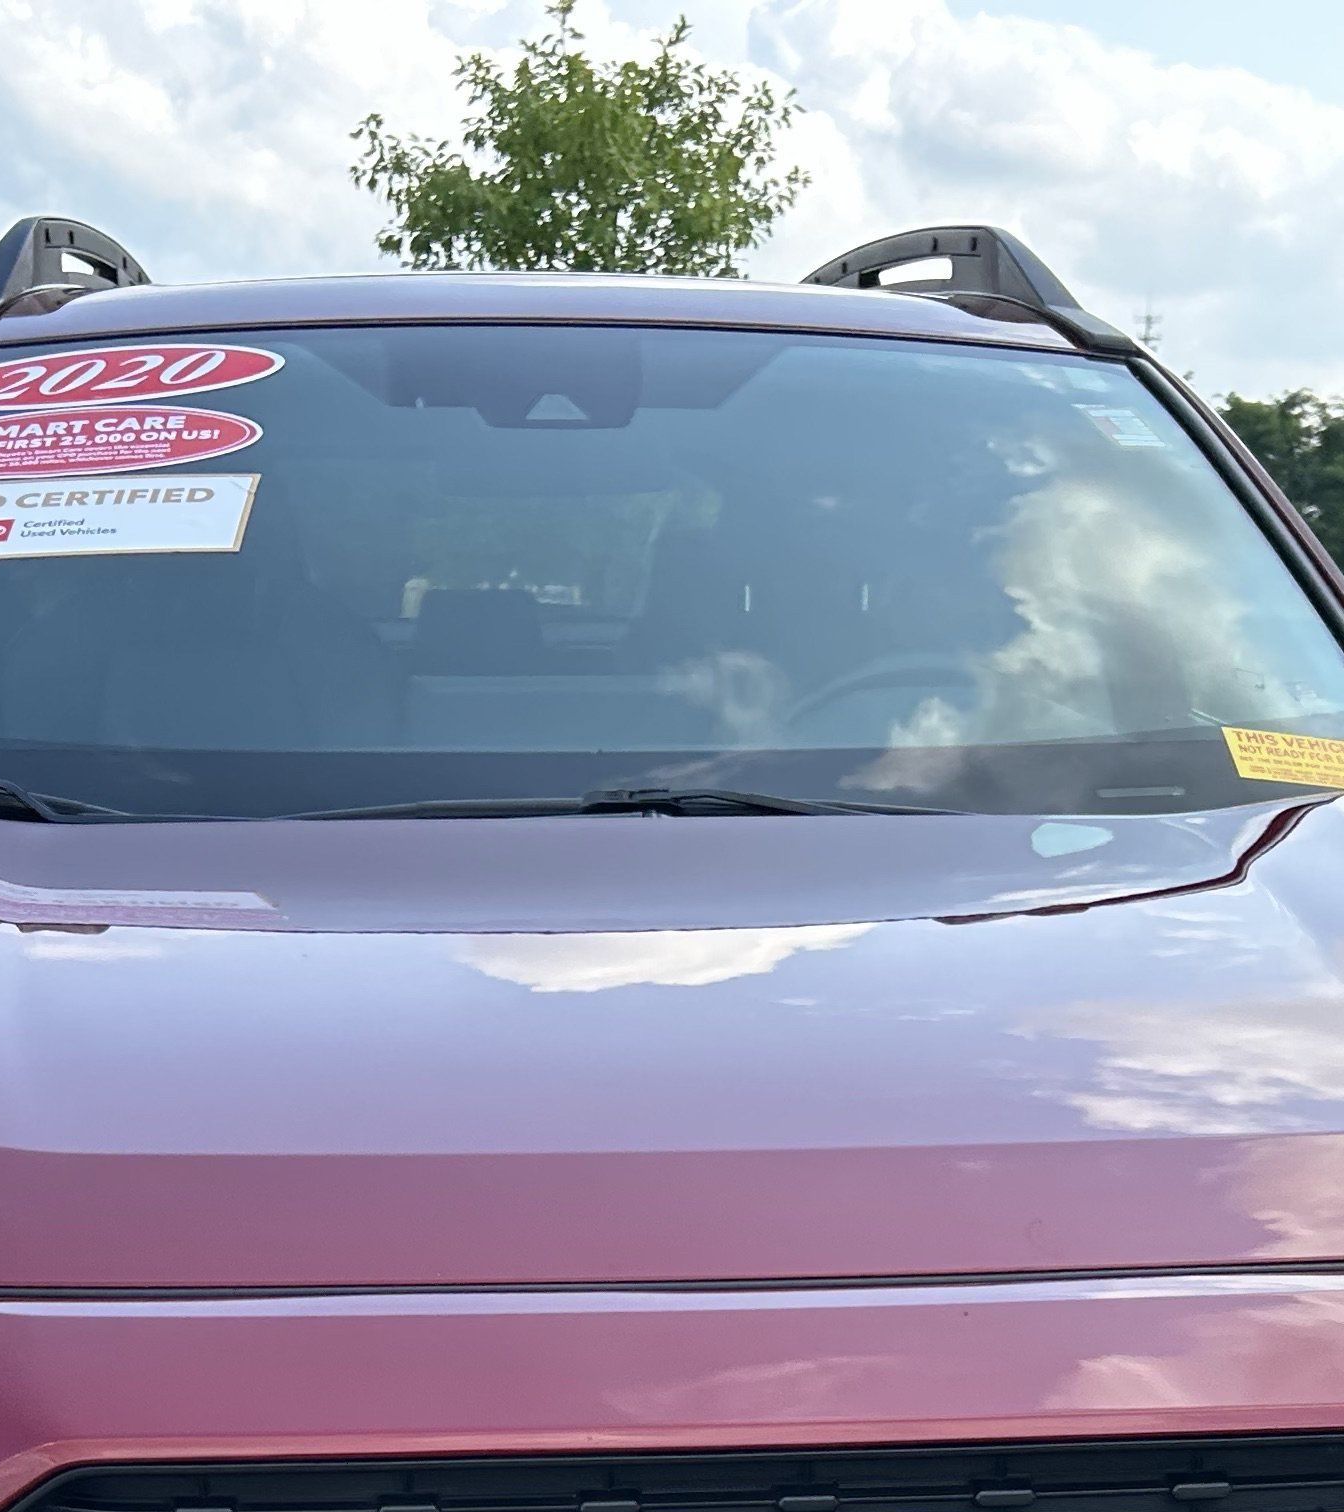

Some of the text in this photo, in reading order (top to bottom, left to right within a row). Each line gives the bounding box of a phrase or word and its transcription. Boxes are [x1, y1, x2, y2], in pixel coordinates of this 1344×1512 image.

[95, 416, 187, 431] CARE
[59, 433, 136, 446] 25,000
[140, 431, 177, 441] ON
[181, 430, 220, 440] US!
[15, 487, 215, 509] CERTIFIED
[23, 518, 85, 529] Certified
[20, 526, 117, 538] Used Vehicles
[1233, 730, 1278, 746] THIS
[1239, 744, 1262, 754] NOT
[1266, 746, 1306, 759] READY
[1309, 752, 1334, 762] FOR
